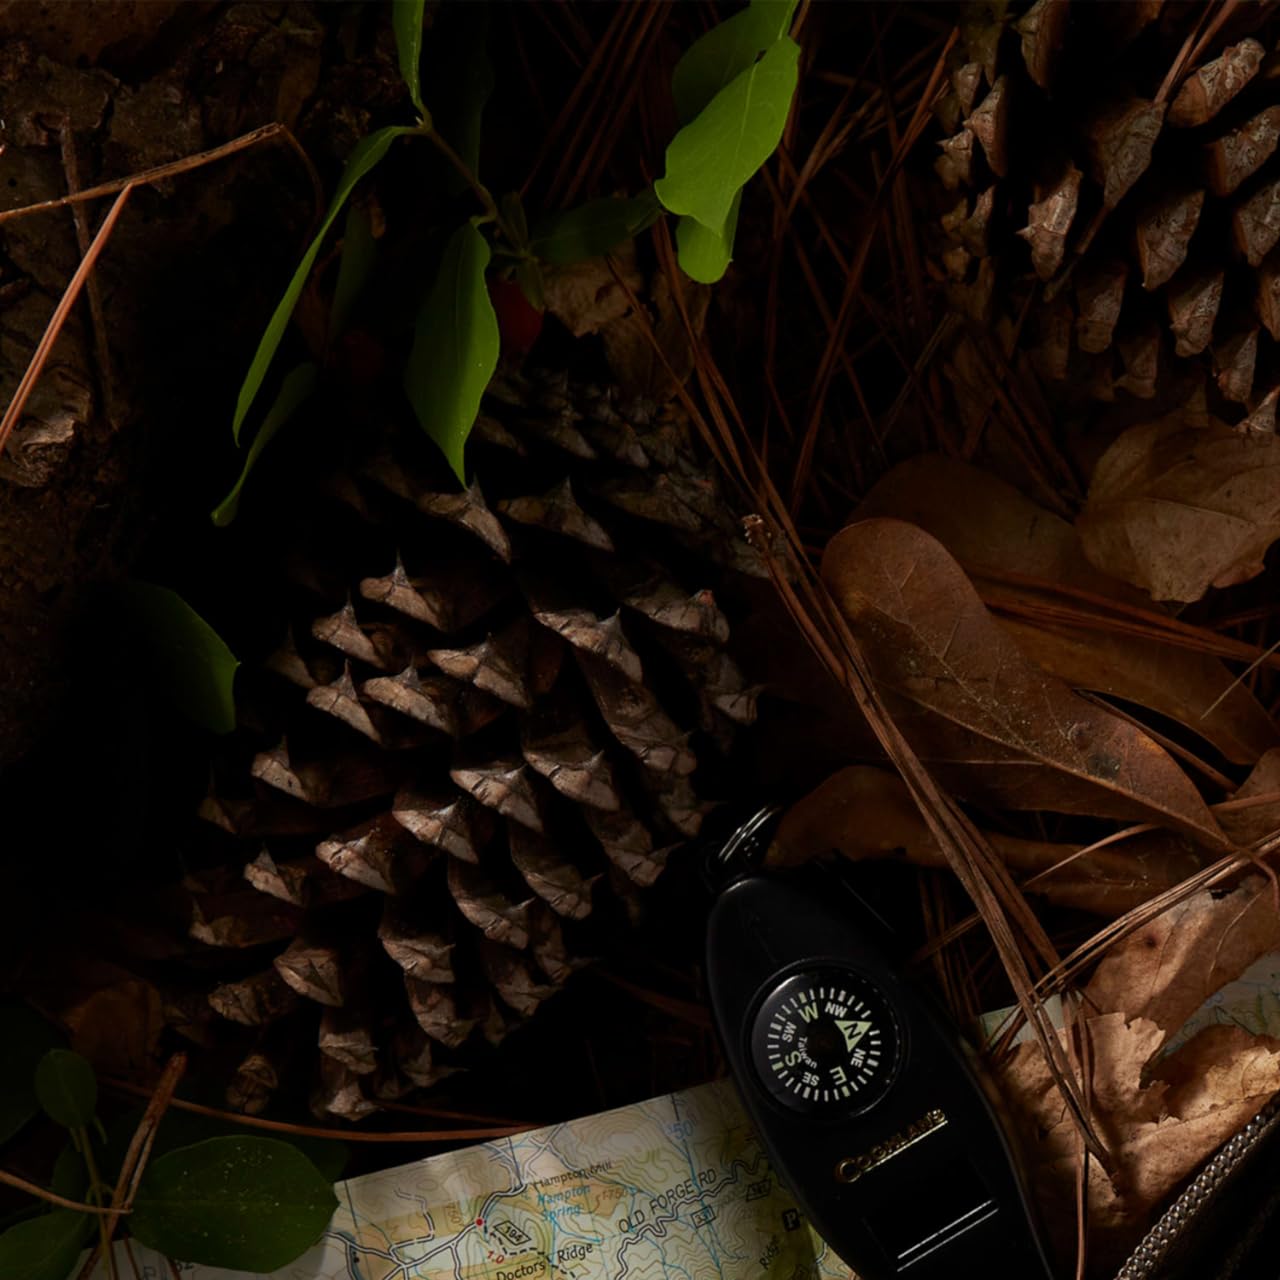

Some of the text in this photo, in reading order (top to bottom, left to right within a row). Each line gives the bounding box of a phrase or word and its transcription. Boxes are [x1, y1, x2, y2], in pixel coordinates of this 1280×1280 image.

[797, 1001, 819, 1024] W
[824, 1001, 848, 1019] NW
[782, 1021, 797, 1043] SW
[843, 1022, 862, 1040] N
[784, 1050, 802, 1067] S
[850, 1047, 867, 1068] NE
[801, 1071, 820, 1087] SE
[829, 1065, 848, 1086] E
[618, 1209, 646, 1234] OLD
[649, 1181, 694, 1214] FORGE
[699, 1168, 717, 1189] RD
[504, 1226, 522, 1243] 194
[556, 1242, 594, 1264] Ridge
